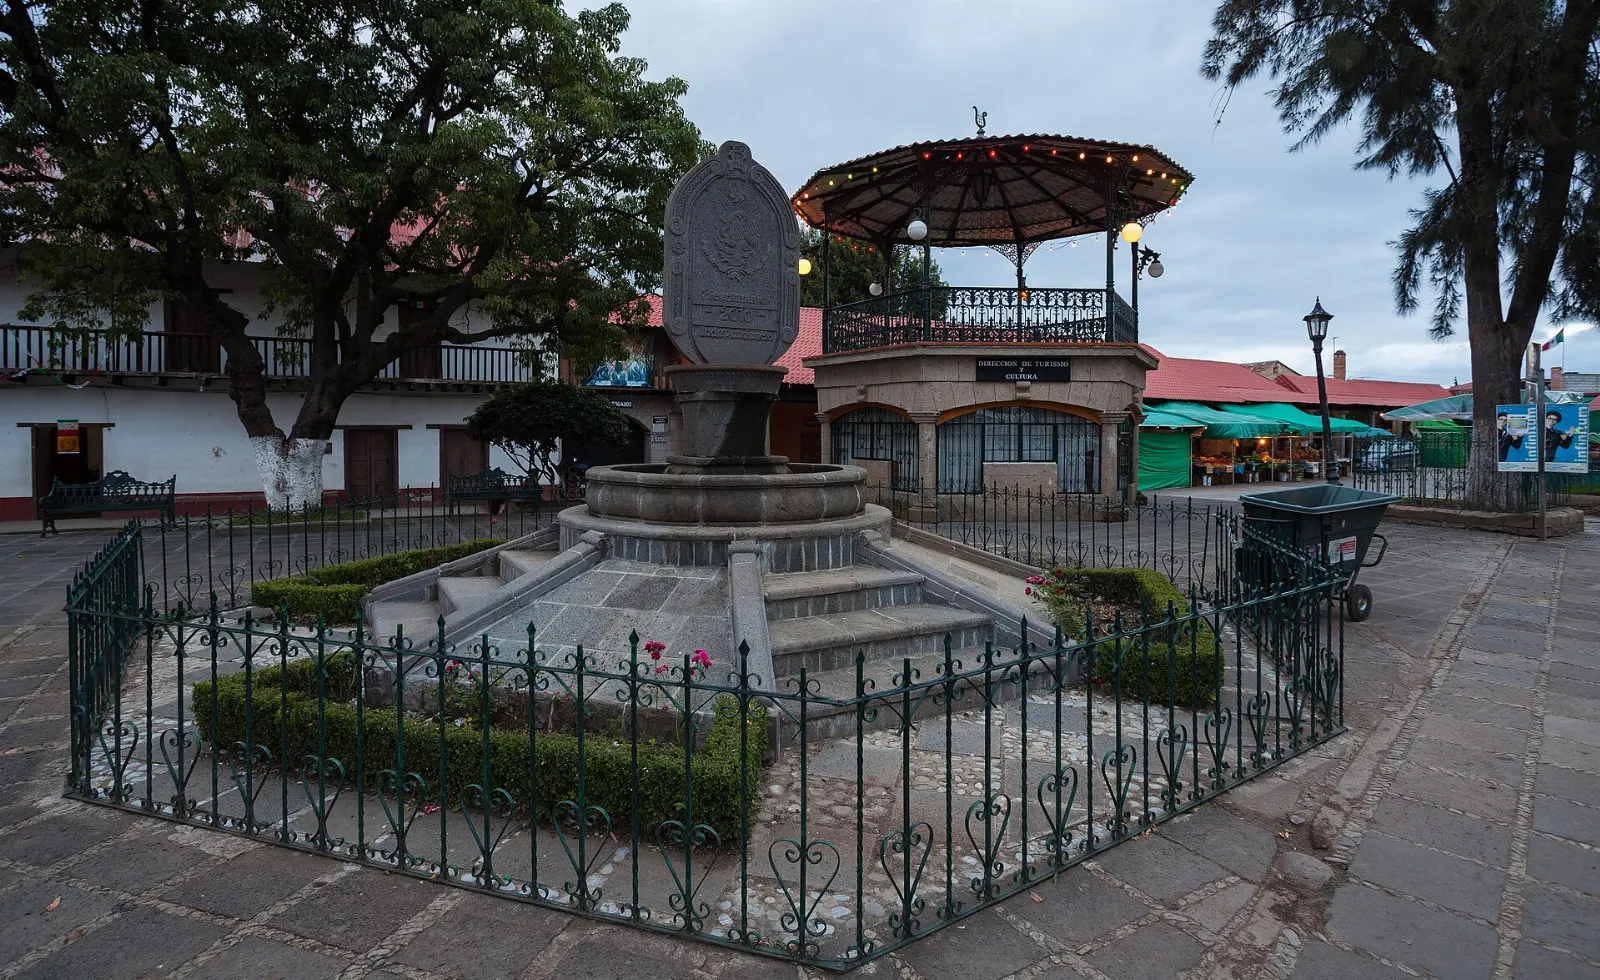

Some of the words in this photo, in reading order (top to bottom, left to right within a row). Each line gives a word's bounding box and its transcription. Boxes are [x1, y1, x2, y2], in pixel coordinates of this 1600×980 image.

[720, 306, 754, 324] 2010
[1525, 407, 1537, 461] infinitum
[1574, 406, 1588, 462] infinitum
